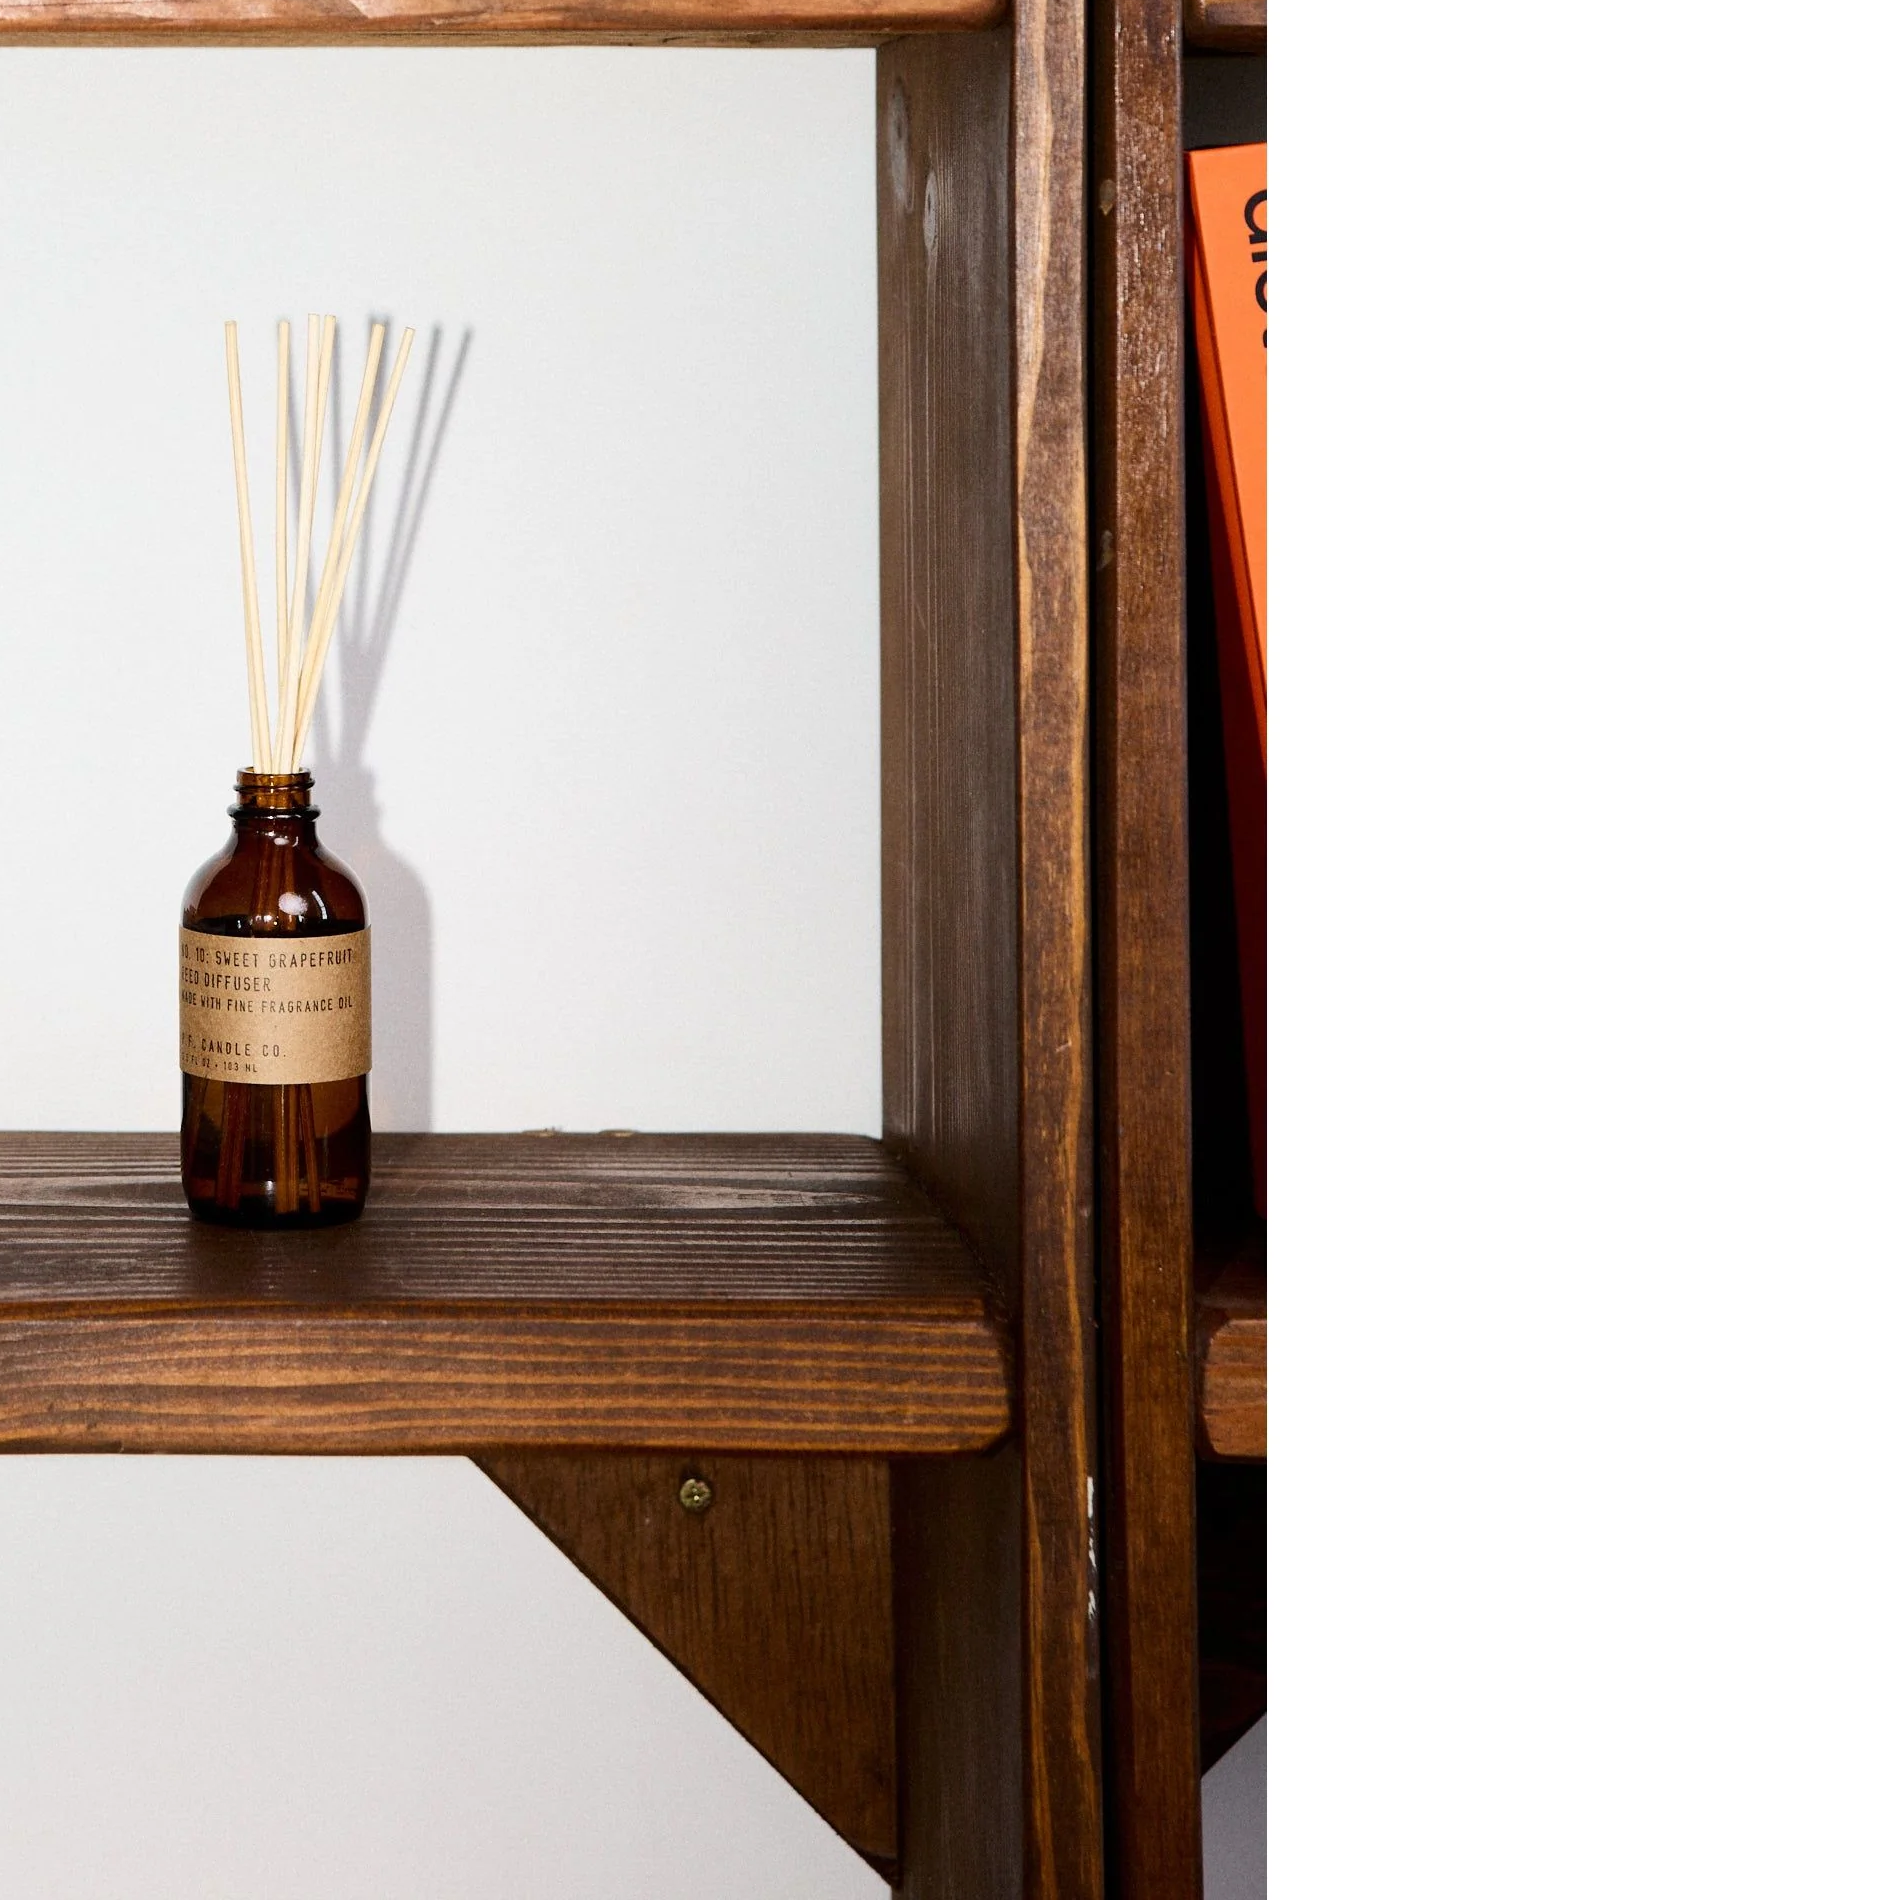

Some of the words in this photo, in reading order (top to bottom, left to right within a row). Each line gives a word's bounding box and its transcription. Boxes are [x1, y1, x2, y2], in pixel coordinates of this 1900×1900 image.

[195, 947, 209, 964] 10:
[215, 950, 259, 968] SWEET
[269, 948, 353, 968] GRAPEFRUIT
[204, 972, 271, 992] DIFFUSER
[200, 994, 221, 1011] WITH
[227, 998, 254, 1013] FINE
[261, 998, 333, 1014] FRAGRANCE
[338, 995, 353, 1010] OIL
[201, 1038, 252, 1057] CANDLE
[262, 1044, 287, 1058] CO.
